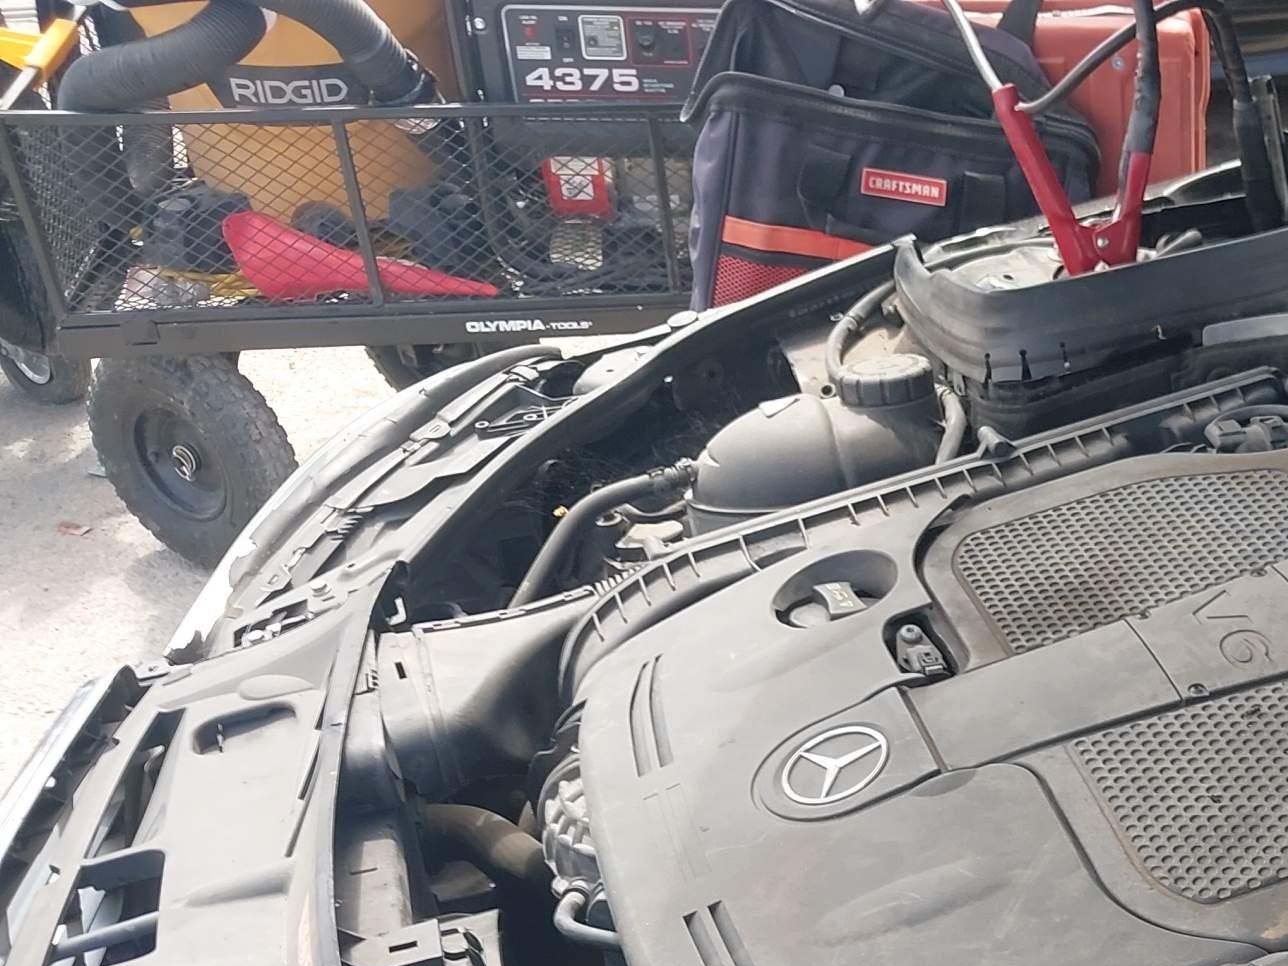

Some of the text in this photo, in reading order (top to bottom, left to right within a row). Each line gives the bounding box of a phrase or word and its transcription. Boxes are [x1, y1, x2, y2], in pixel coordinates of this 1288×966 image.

[229, 77, 349, 104] RIDGID
[525, 67, 639, 92] 4375
[868, 177, 940, 198] CRAFTSMAN
[465, 319, 545, 332] OLYMPIA
[1192, 589, 1272, 671] V6
